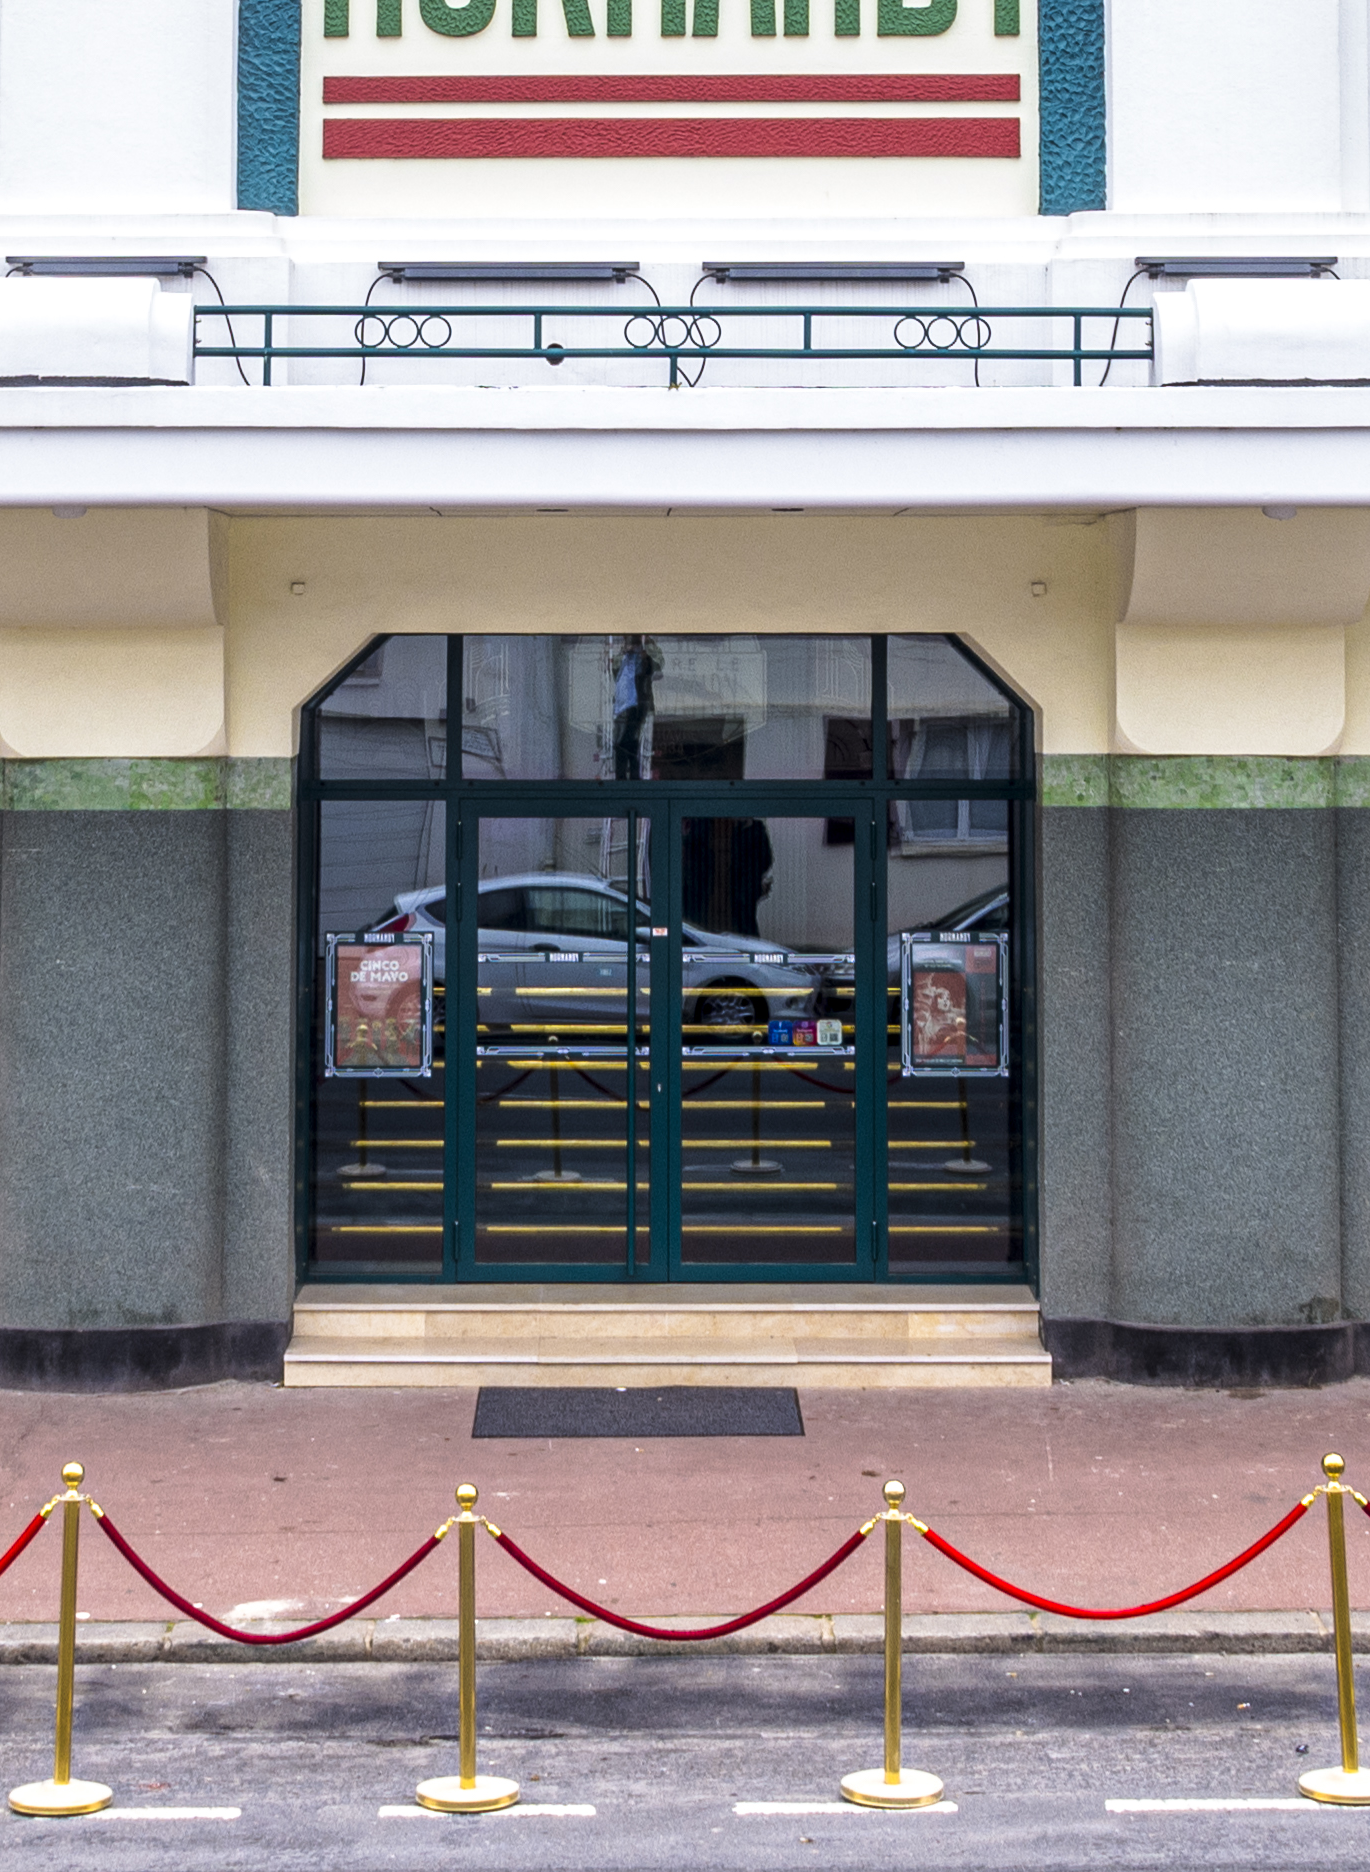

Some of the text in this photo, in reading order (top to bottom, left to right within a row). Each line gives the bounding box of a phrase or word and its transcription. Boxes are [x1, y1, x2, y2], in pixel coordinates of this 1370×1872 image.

[360, 960, 399, 971] CINCO
[350, 971, 408, 982] DE MAYO
